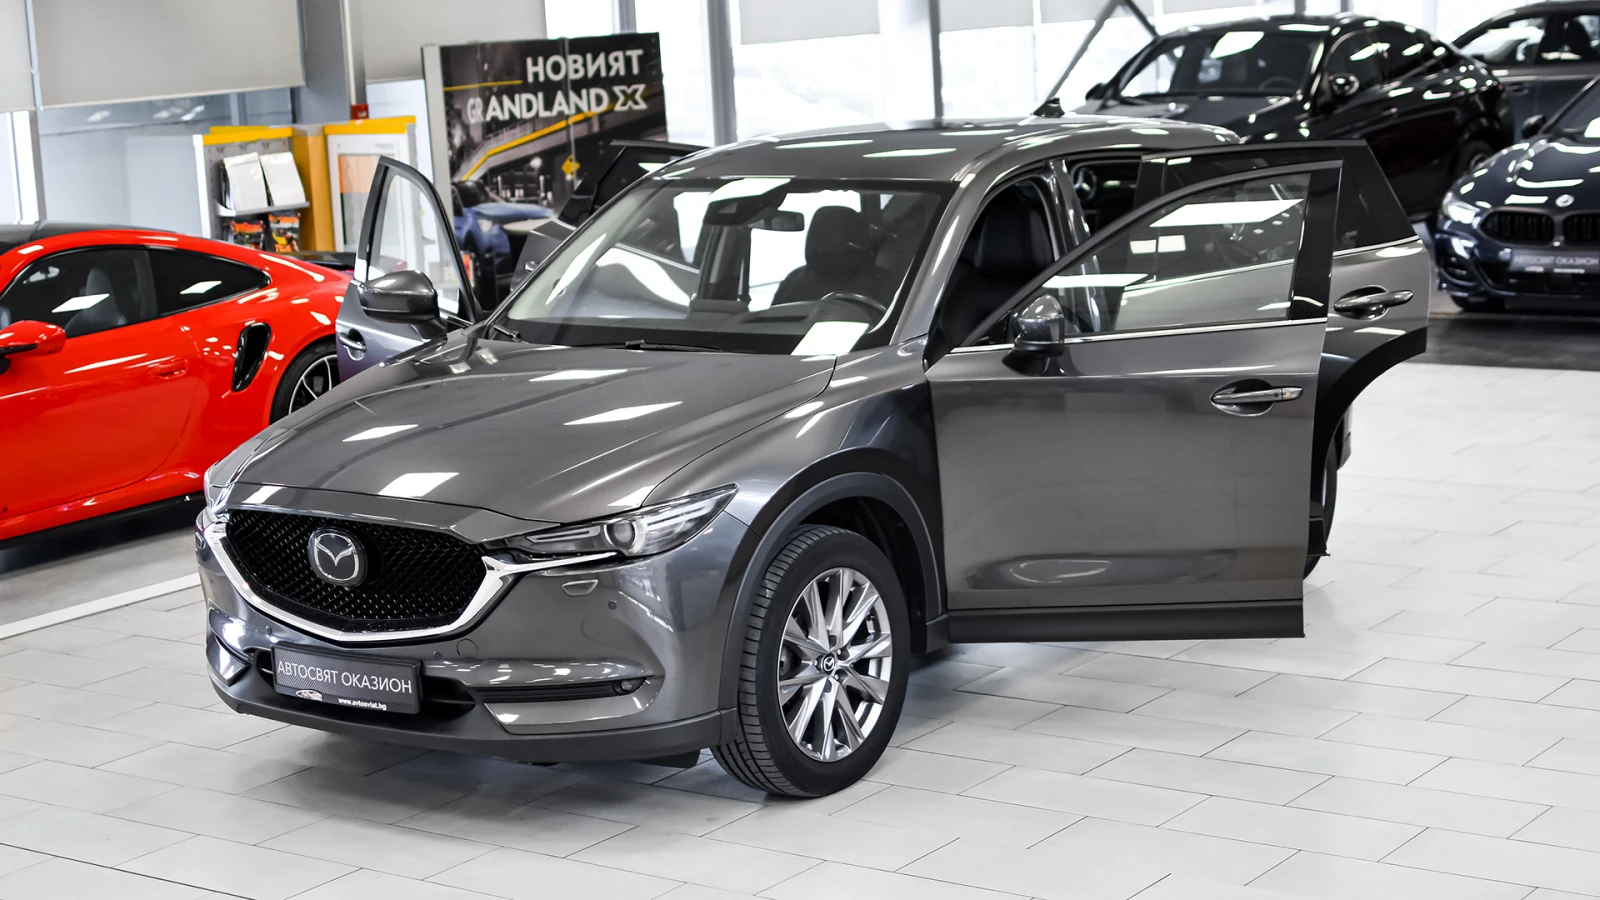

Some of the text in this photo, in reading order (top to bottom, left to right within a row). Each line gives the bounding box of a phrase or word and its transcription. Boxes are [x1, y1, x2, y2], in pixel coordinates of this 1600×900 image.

[526, 49, 643, 83] НОВИЯТ
[277, 661, 412, 693] АВТОСВЯТ ОКАЗИОН
[338, 698, 387, 710] www.avtosviat.bg
